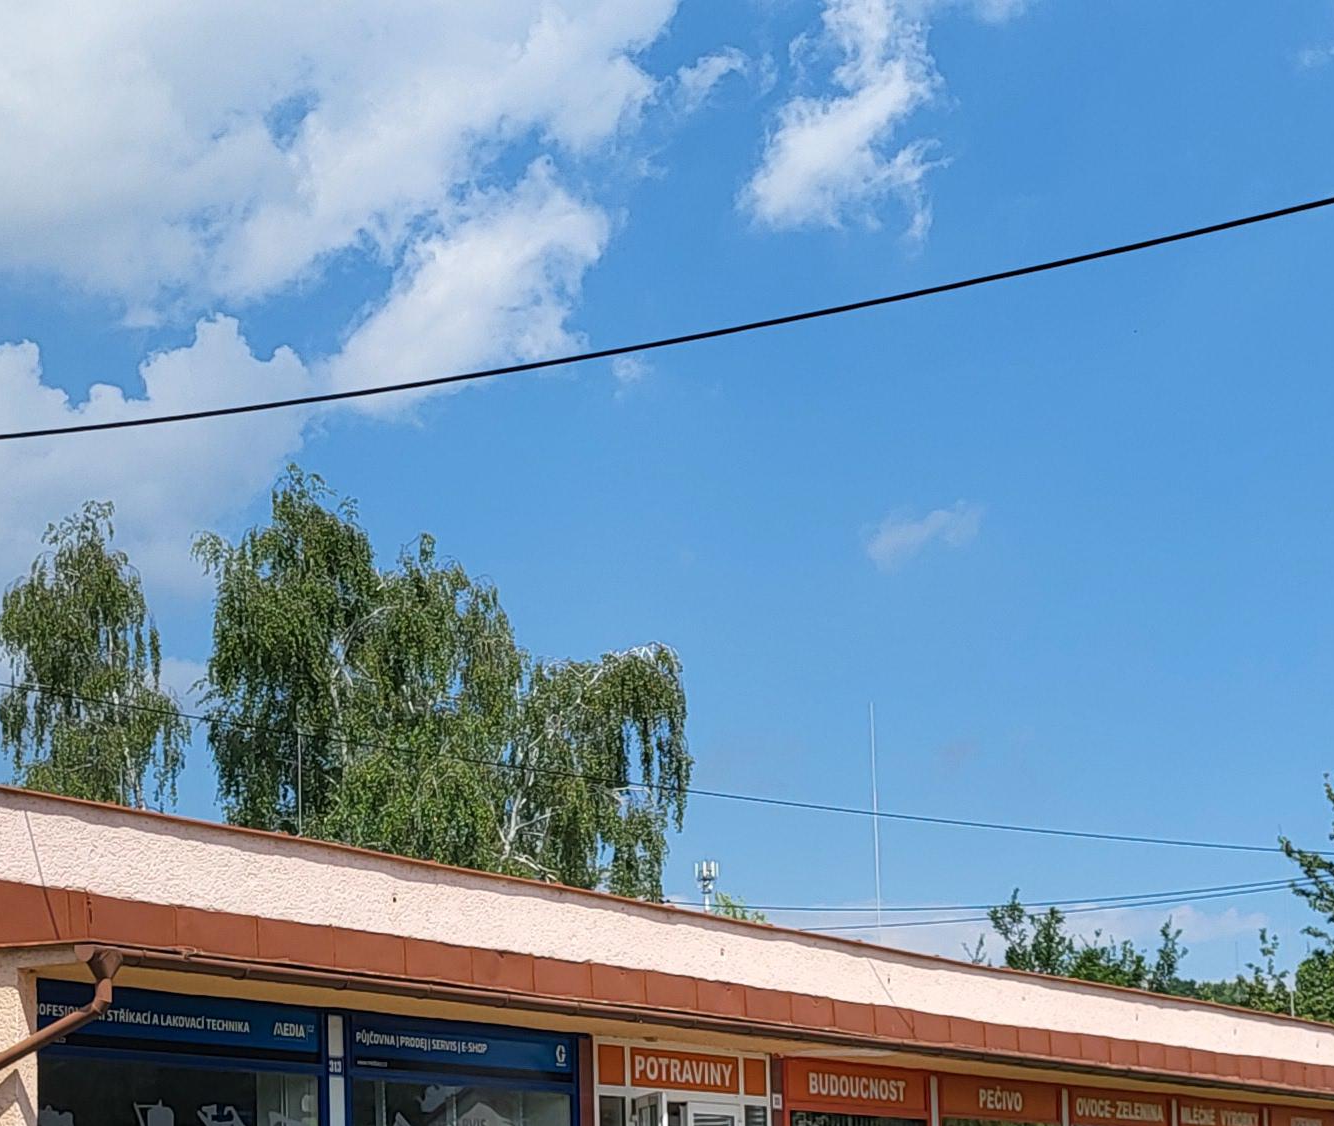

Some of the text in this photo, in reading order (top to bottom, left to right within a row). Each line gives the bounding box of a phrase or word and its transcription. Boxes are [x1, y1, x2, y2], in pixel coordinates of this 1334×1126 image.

[107, 1007, 151, 1026] STŘÍKACÍ
[152, 1014, 160, 1026] A
[161, 1013, 205, 1030] LAKOVACÍ
[206, 1018, 250, 1033] TECHNIKA
[273, 1021, 306, 1038] MEDIA
[356, 1029, 488, 1054] PŮJČOVNA PRODEJ SERVIS E-SHOP
[634, 1054, 734, 1088] POTRAVINY
[808, 1072, 906, 1102] BUDOUCNOST
[978, 1085, 1023, 1112] PEČIVO
[1076, 1097, 1165, 1122] OVOCE-ZELENINA
